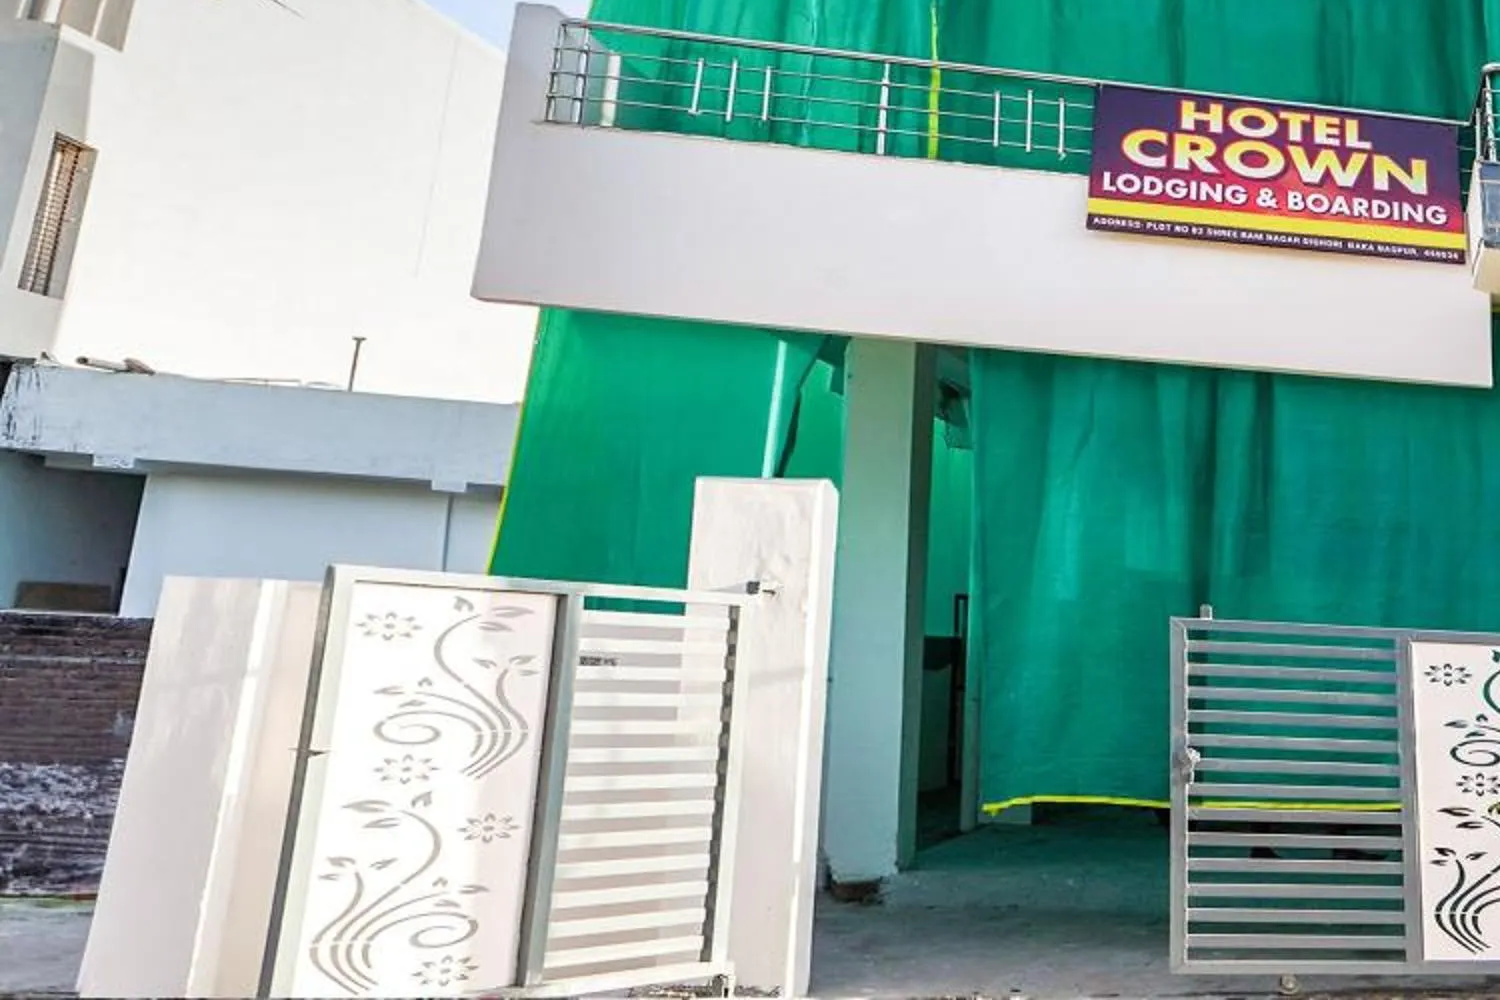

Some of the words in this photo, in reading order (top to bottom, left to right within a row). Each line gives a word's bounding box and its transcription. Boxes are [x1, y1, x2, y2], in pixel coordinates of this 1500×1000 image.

[1180, 99, 1372, 149] HOTEL
[1121, 128, 1429, 196] CROWN
[1103, 170, 1248, 206] LODGING
[1256, 186, 1280, 209] &
[1287, 189, 1448, 225] BOARDING
[1146, 221, 1171, 231] PLOT
